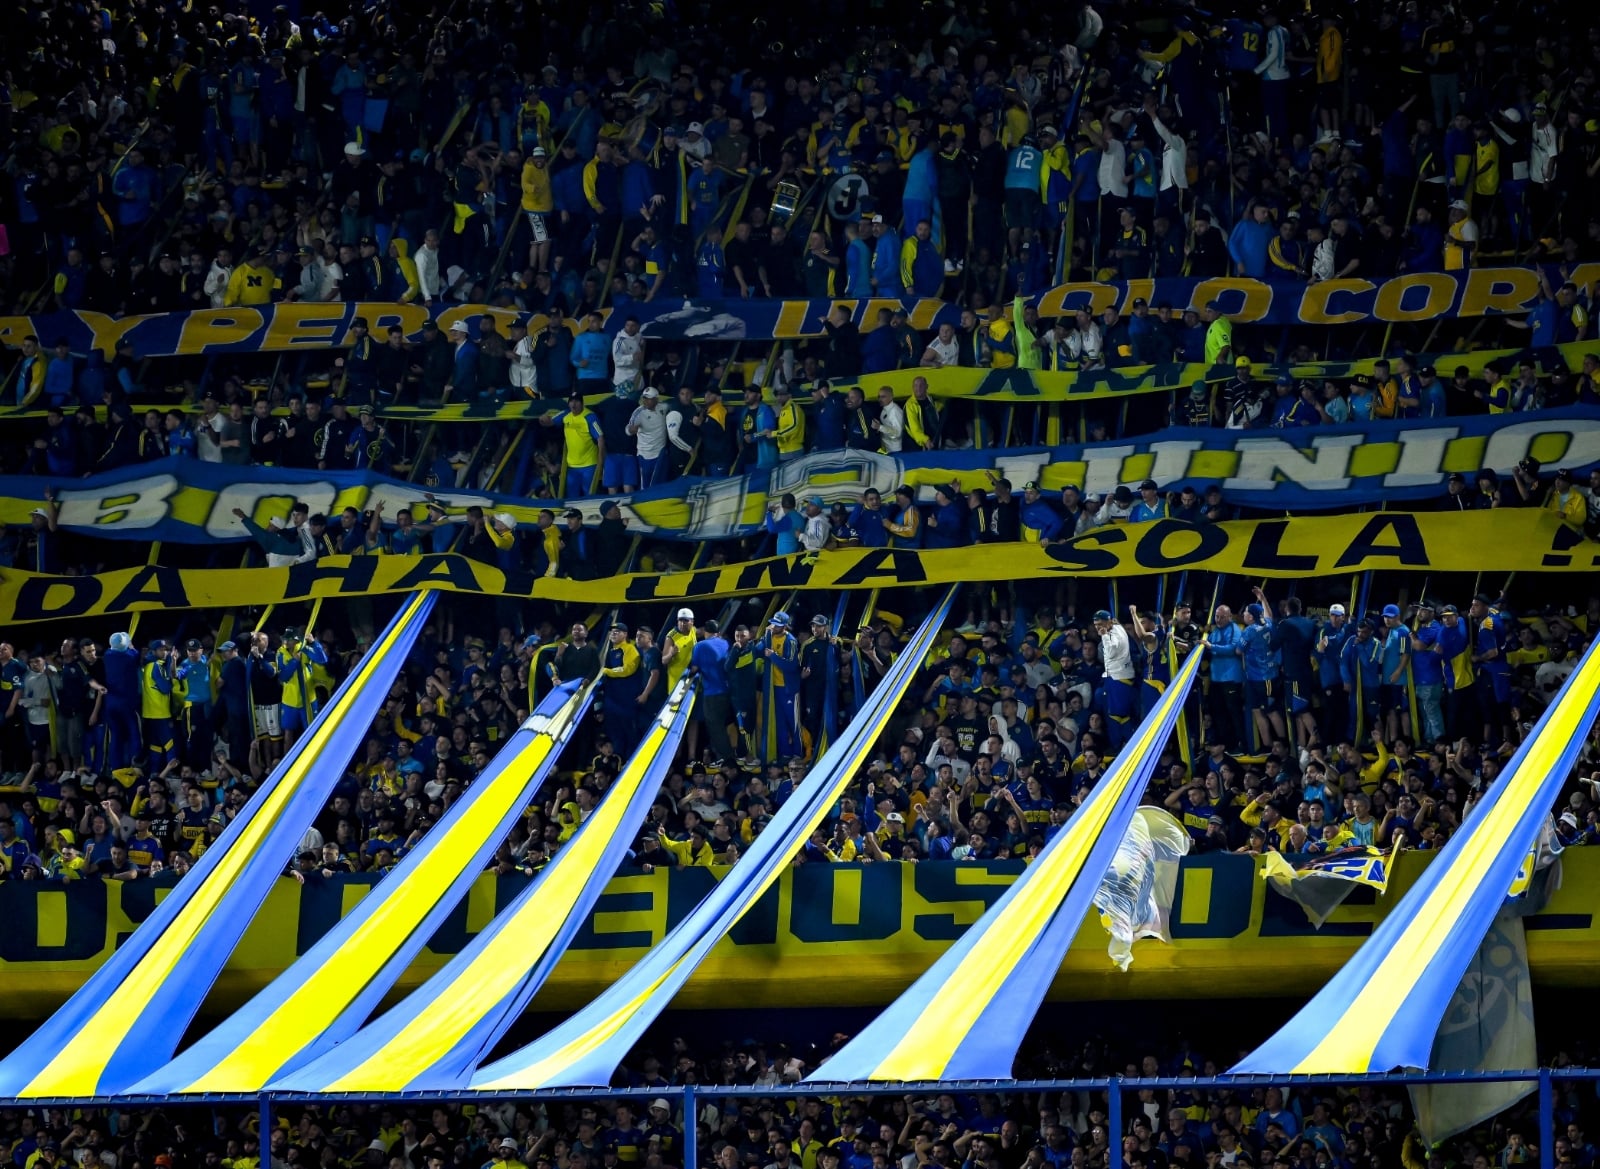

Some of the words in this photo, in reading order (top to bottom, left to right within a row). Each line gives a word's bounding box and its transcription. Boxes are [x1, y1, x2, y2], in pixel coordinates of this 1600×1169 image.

[1242, 31, 1258, 53] 12
[1014, 150, 1034, 170] 12
[834, 179, 862, 216] J
[973, 277, 1275, 326] OLO
[1041, 513, 1430, 572] SOLA
